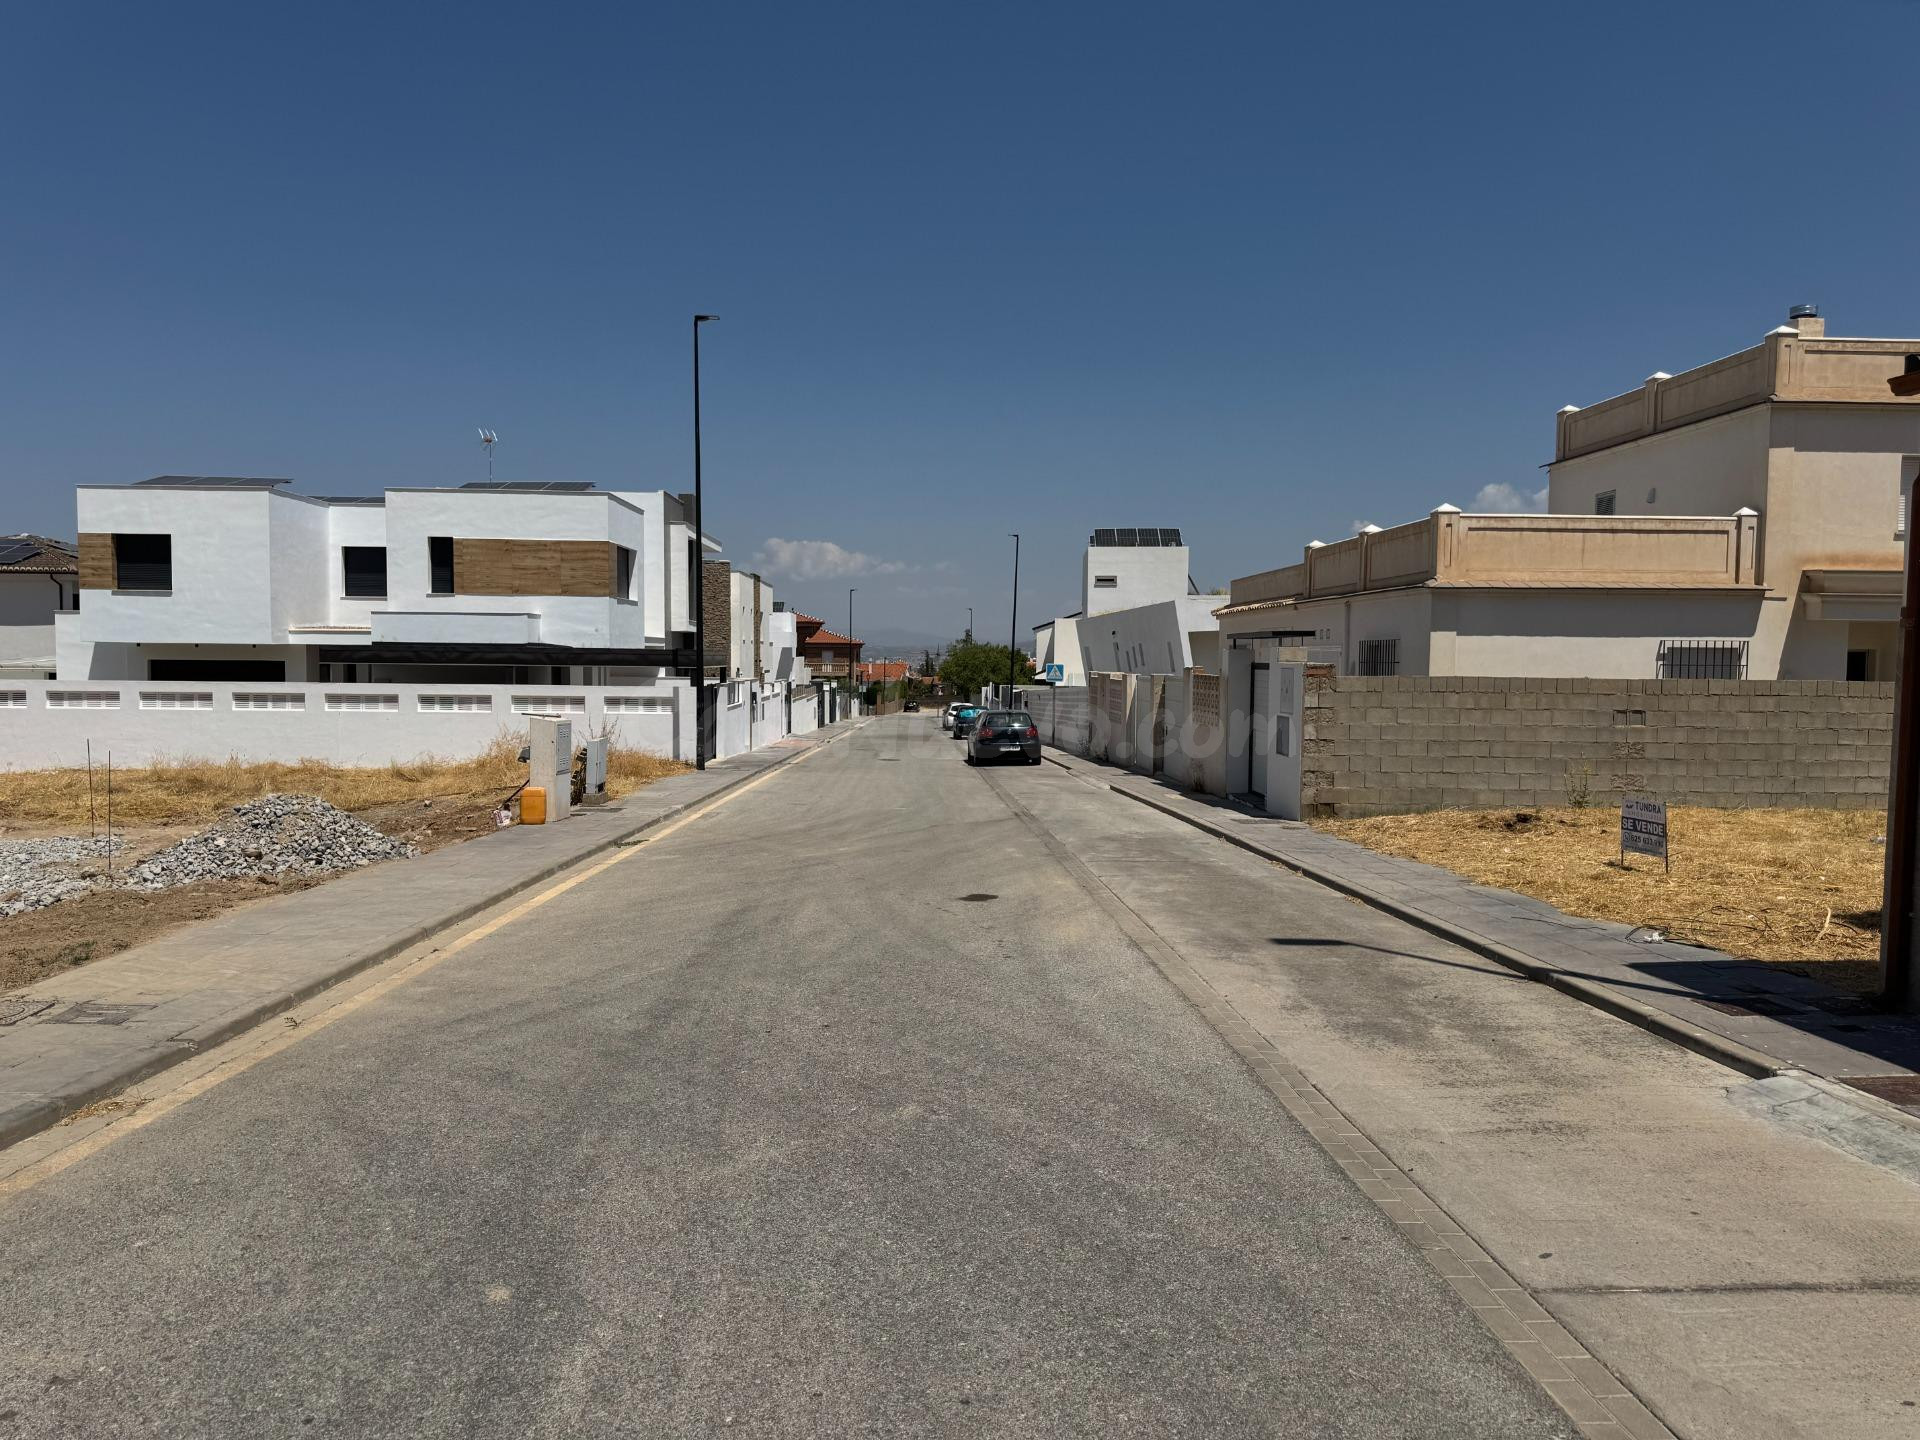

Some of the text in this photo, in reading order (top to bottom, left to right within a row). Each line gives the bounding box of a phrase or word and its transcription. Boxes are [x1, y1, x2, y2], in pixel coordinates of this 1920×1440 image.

[1636, 801, 1662, 815] TUNDRA
[1622, 818, 1664, 836] SE VENDE
